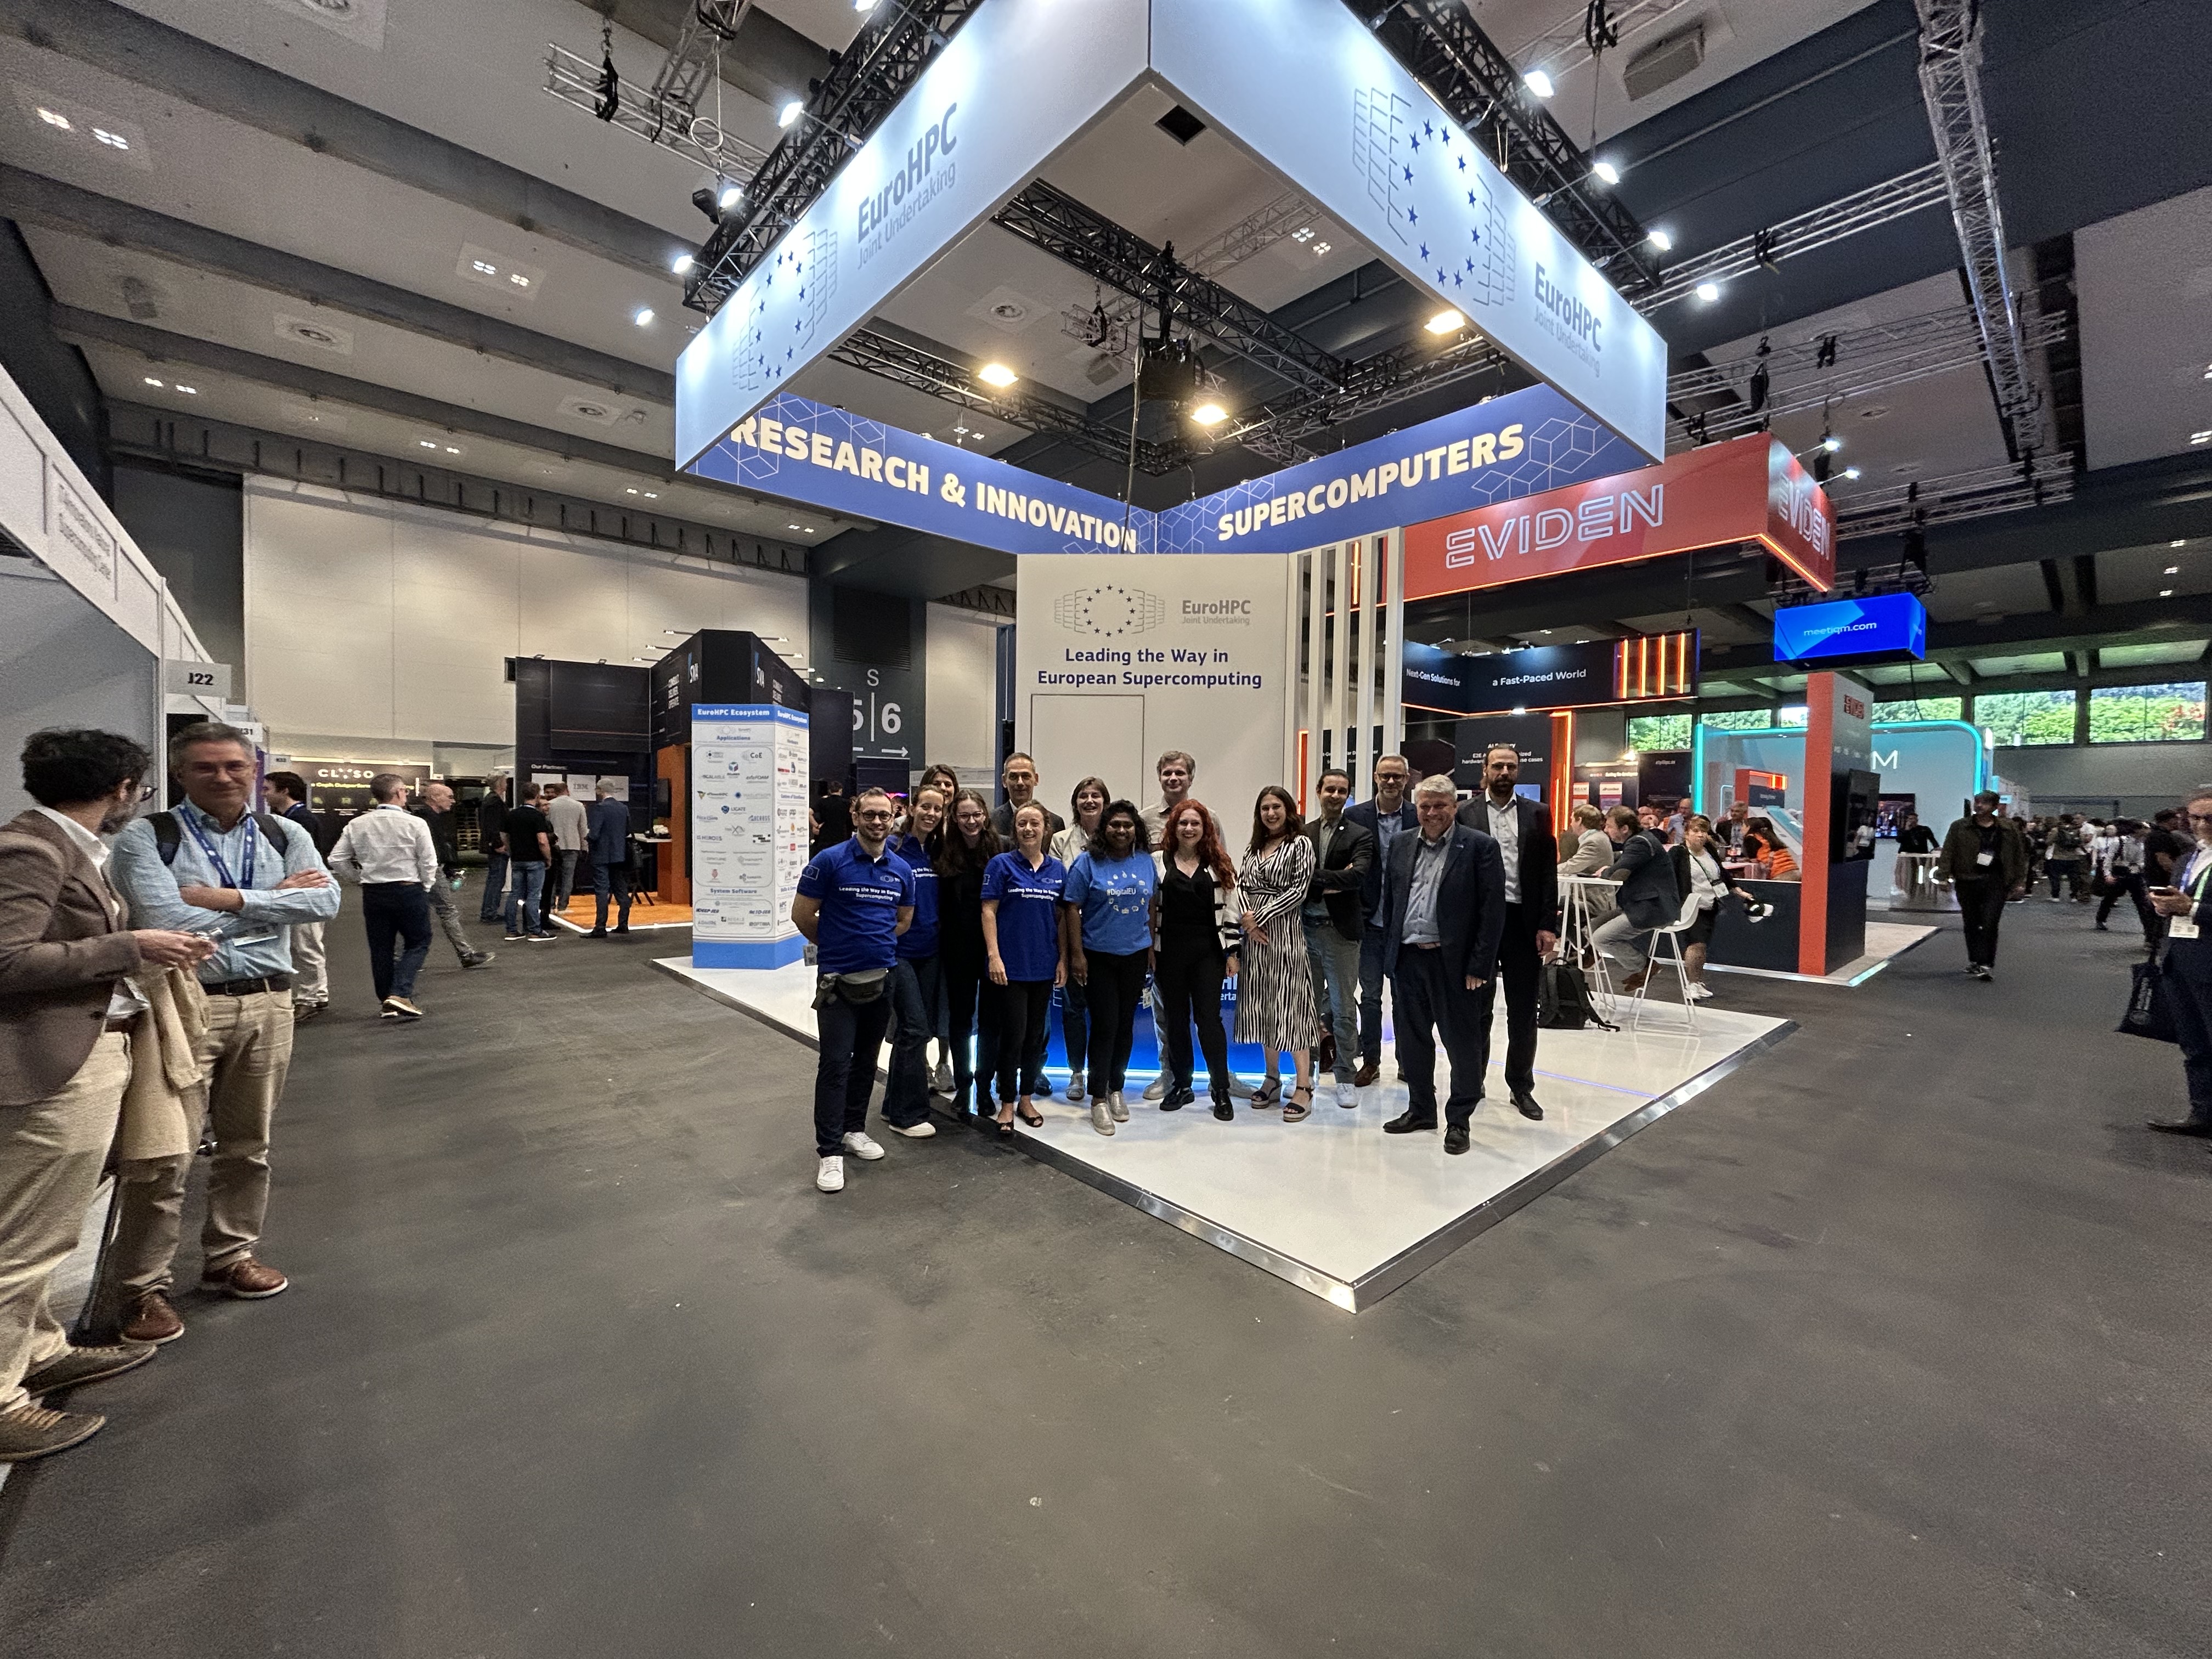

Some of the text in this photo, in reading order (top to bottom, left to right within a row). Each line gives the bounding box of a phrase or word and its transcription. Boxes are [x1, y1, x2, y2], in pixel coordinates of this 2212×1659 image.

[858, 102, 957, 242] EuroHPC
[858, 162, 956, 270] Joint Undertaking
[1535, 261, 1602, 352] EuroHPC
[1534, 306, 1601, 379] Joint Undertaking
[730, 415, 1137, 554] RESEARCH & INNOVATION
[1218, 424, 1525, 541] SUPERCOMPUTERS
[1778, 472, 1831, 560] EVIDEN
[1446, 483, 1664, 569] EVIDEN
[1182, 600, 1251, 614] EuroHPC
[1182, 616, 1250, 625] Joint Undertaking
[1804, 622, 1877, 636] meetiqm.com
[1065, 648, 1228, 665] Leading the Way in
[188, 673, 214, 686] J22
[867, 668, 879, 686] S
[1038, 671, 1262, 689] European Supercomputing
[1406, 668, 1430, 681] Next-Gen
[1430, 671, 1453, 686] Solutions
[1500, 672, 1553, 685] Fast-Paced
[1555, 669, 1587, 680] World
[882, 702, 901, 734] 6
[856, 892, 893, 901] Supercomputing
[1107, 888, 1136, 896] #DigitalEU
